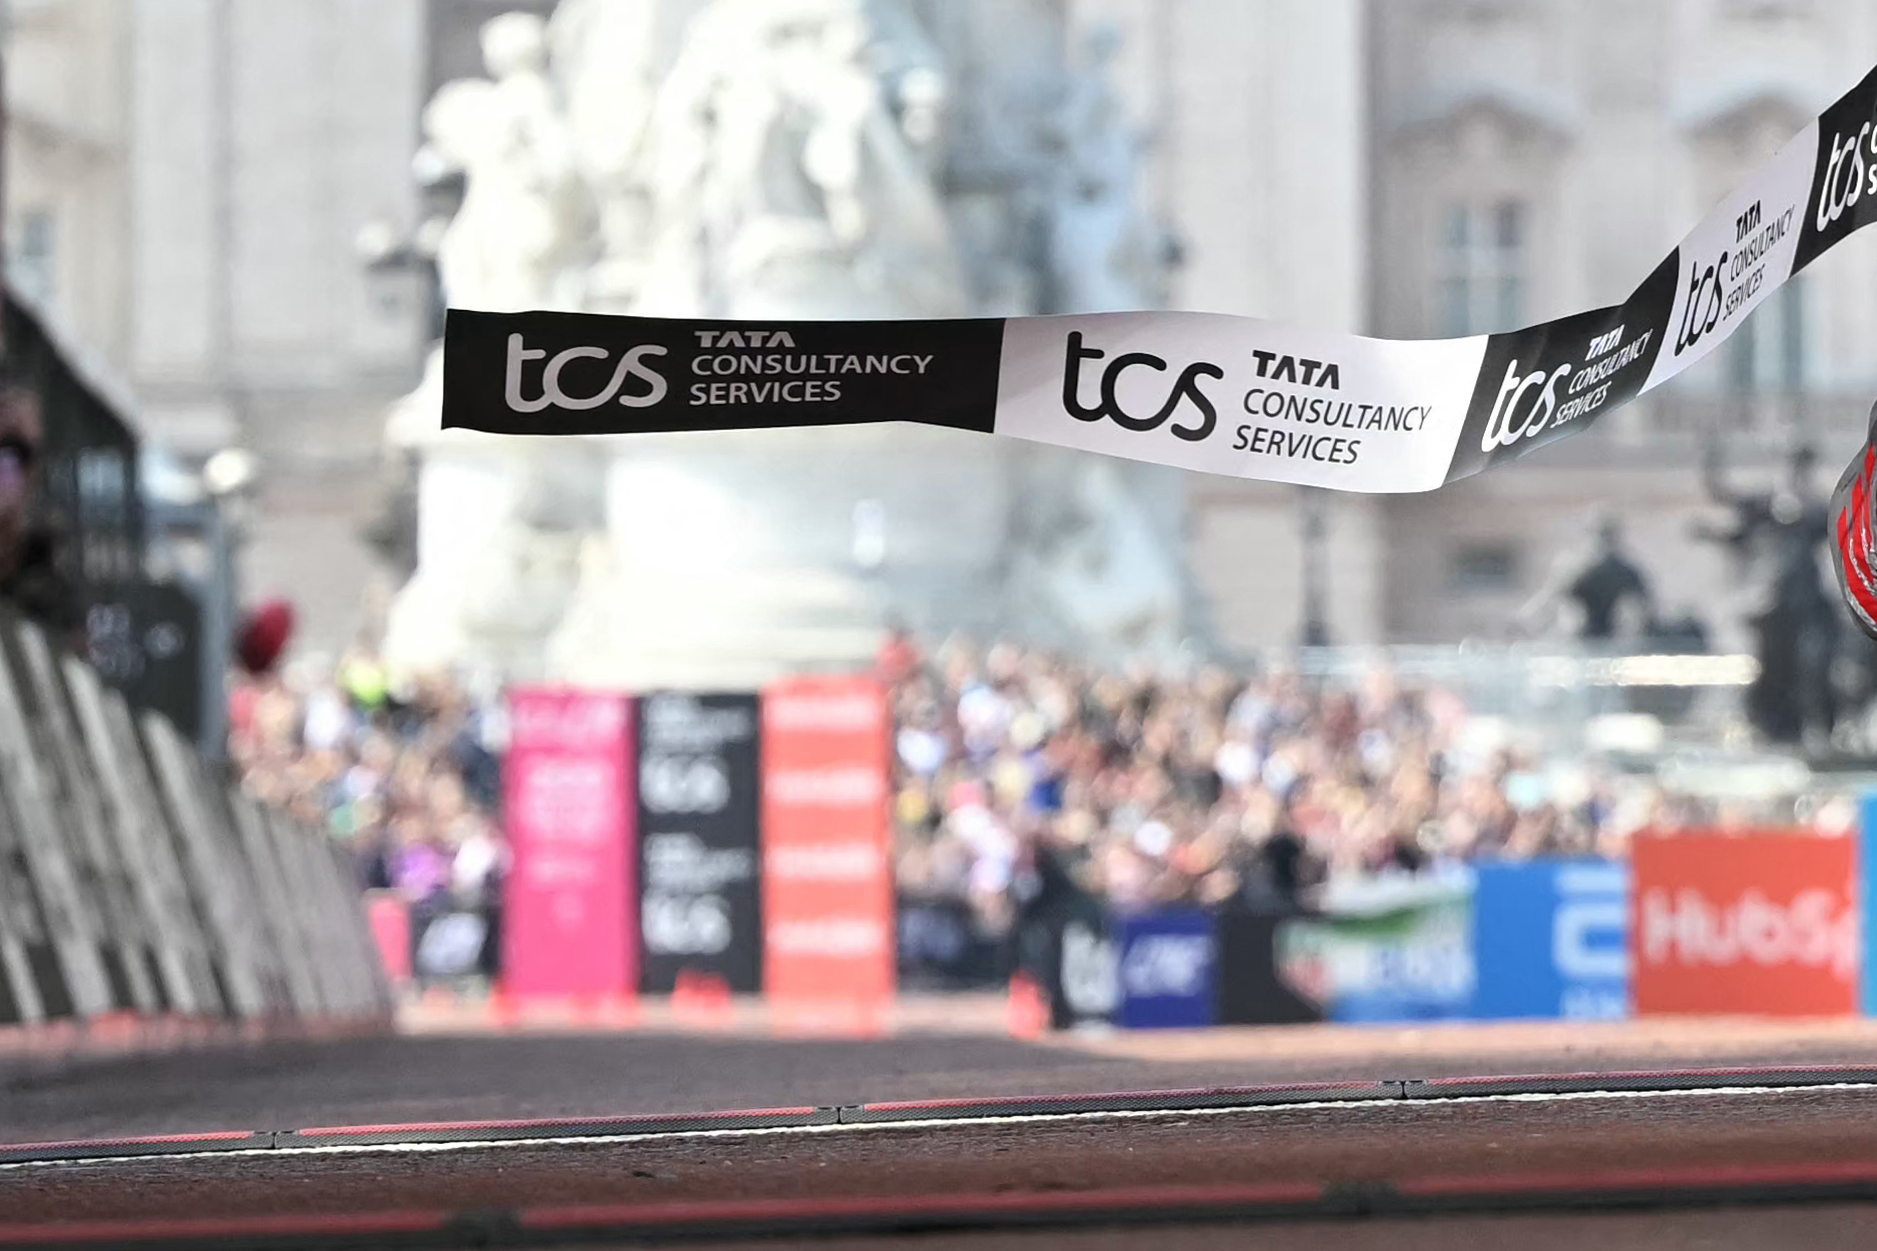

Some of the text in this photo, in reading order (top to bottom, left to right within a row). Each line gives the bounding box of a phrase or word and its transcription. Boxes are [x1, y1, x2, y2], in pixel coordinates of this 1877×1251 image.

[1817, 121, 1871, 232] tcs
[1730, 203, 1796, 282] CONSULTANCY
[1736, 199, 1761, 244] TATA
[1674, 251, 1729, 357] tcs
[1722, 263, 1766, 321] SERVICES
[694, 330, 796, 348] TATA
[1568, 328, 1654, 395] CONSULTANCY
[1585, 324, 1626, 361] TATA
[504, 332, 668, 413] tcs
[691, 354, 934, 376] CONSULTANCY
[1062, 330, 1224, 442] tcs
[1252, 349, 1340, 391] TATA
[689, 380, 842, 406] SERVICES
[1243, 388, 1432, 432] CONSULTANCY
[1481, 359, 1572, 452] tcs
[1550, 381, 1612, 429] SERVICES
[1232, 424, 1361, 465] SERVICES
